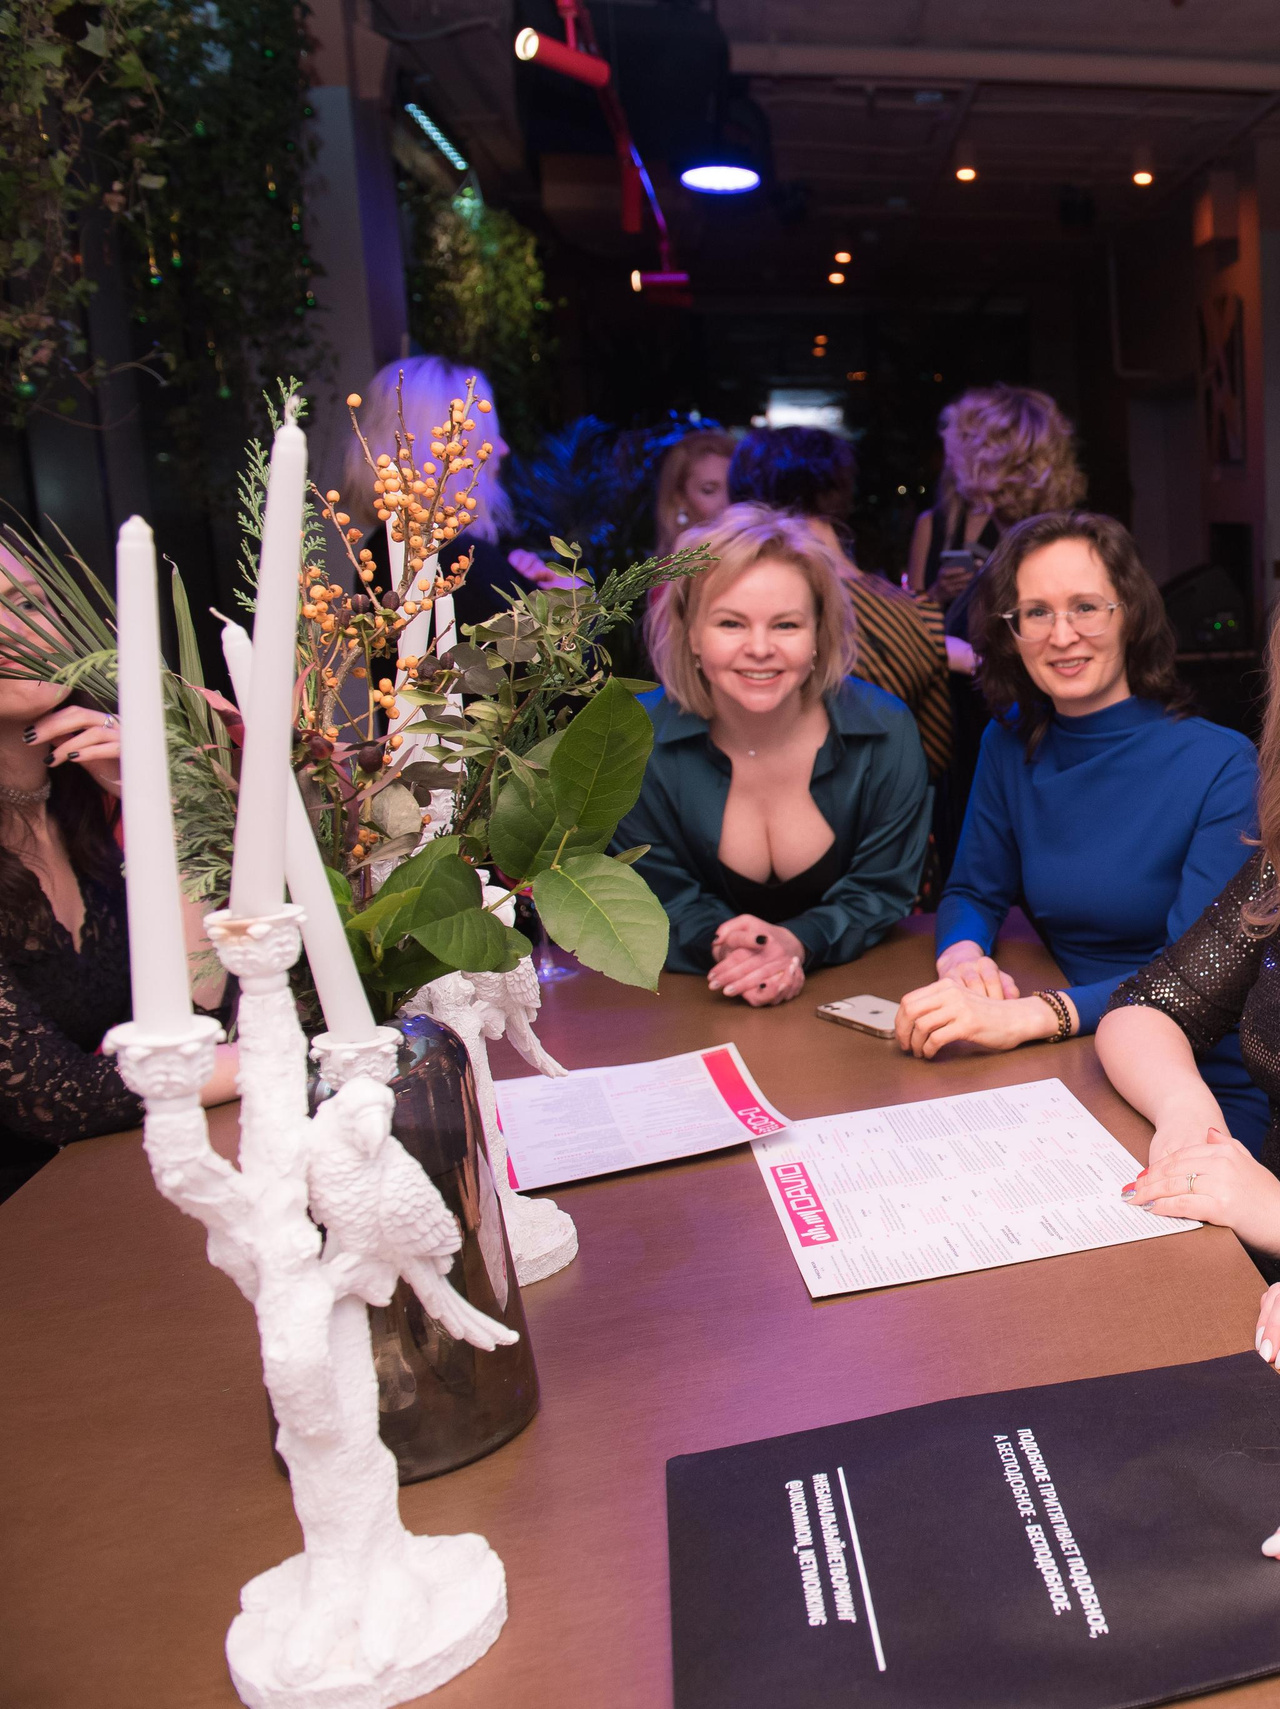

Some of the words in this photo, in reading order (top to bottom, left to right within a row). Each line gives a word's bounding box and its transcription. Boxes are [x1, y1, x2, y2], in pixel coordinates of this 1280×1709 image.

[775, 1164, 818, 1211] DAVID
[796, 1209, 824, 1225] my
[800, 1224, 831, 1241] oh,
[993, 1435, 1008, 1443] А
[996, 1442, 1036, 1517] БЕСПОДОБНОЕ
[785, 1480, 827, 1627] @UNCOMMON_NETWORKING
[811, 1473, 856, 1623] #НЕБАНАЛЬНЫЙНЕТВОРКИНГ
[1016, 1428, 1051, 1482] ПОДОБНОЕ
[1038, 1482, 1081, 1556] ПРИТЯГИВАЕТ
[1066, 1556, 1109, 1638] ПОДОБНОЕ,
[1025, 1524, 1072, 1616] БЕСПОДОБНОЕ.
